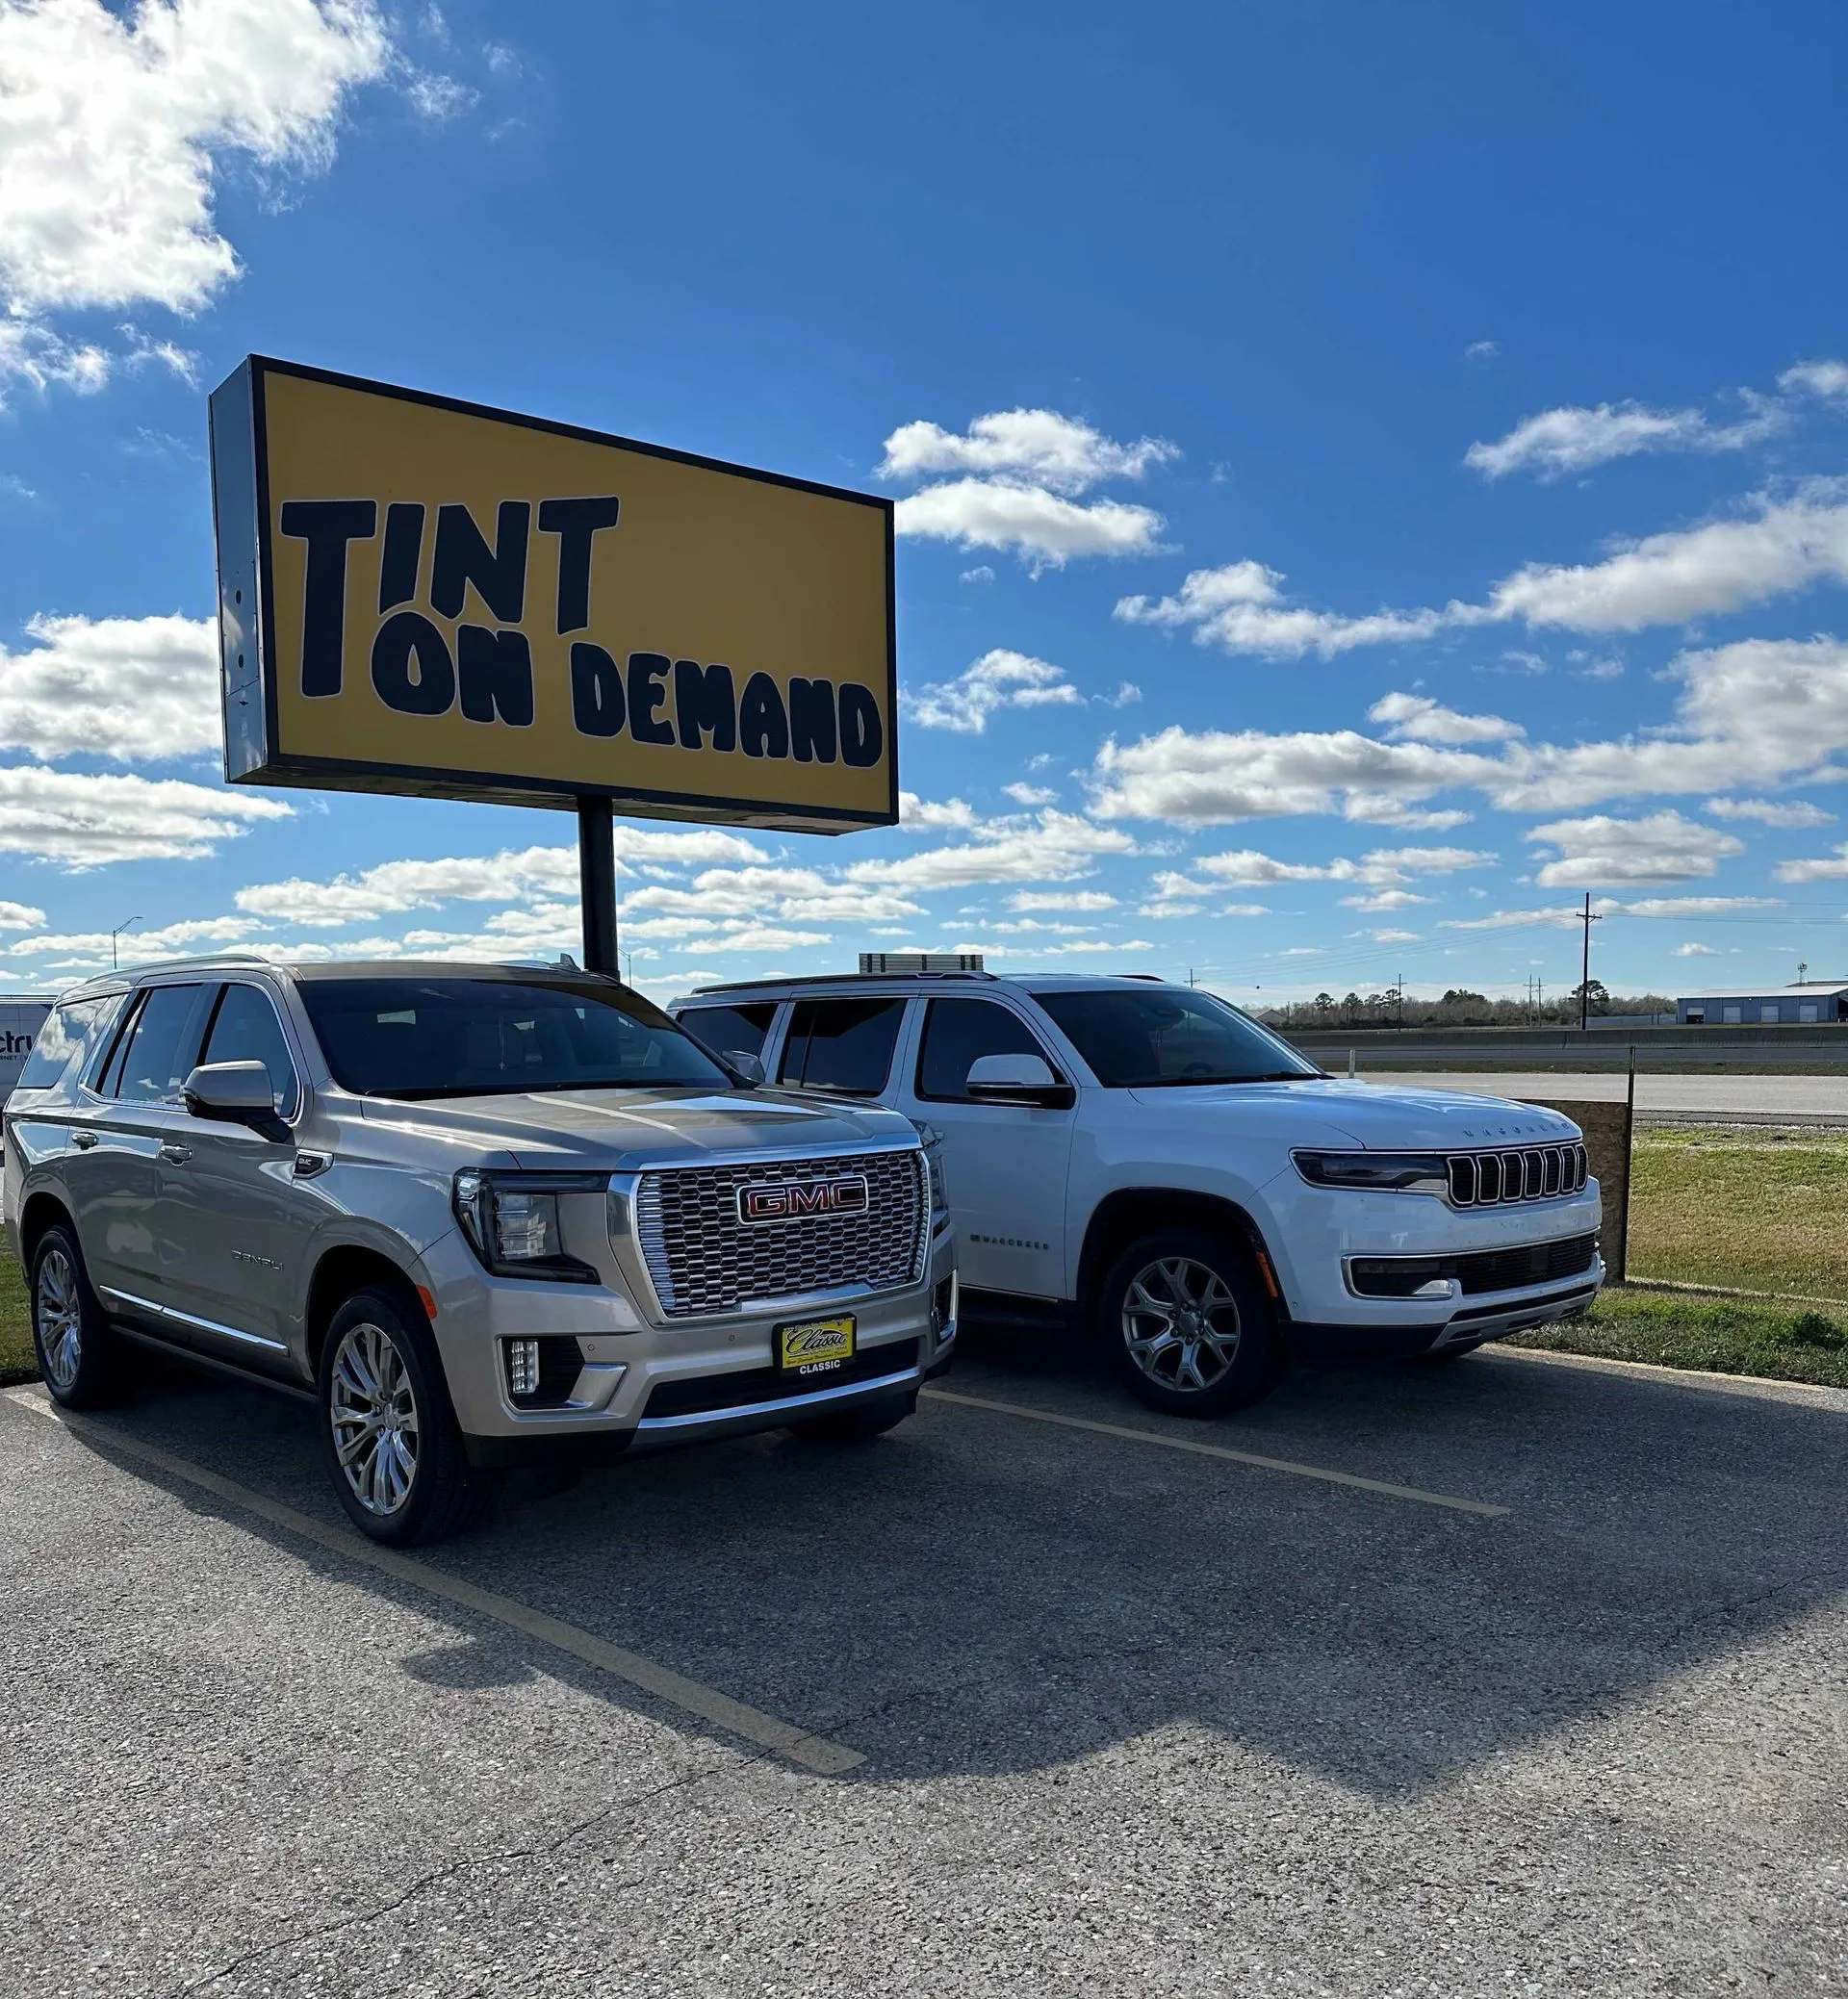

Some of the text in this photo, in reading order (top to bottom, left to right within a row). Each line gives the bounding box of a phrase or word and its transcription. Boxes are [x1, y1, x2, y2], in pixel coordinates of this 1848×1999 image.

[280, 496, 621, 700] TINT
[371, 610, 884, 768] ON DEMAND
[747, 1180, 865, 1218] GMC
[231, 1249, 283, 1271] DENALI
[785, 1328, 849, 1355] Classic
[799, 1359, 841, 1375] CLASSIC
